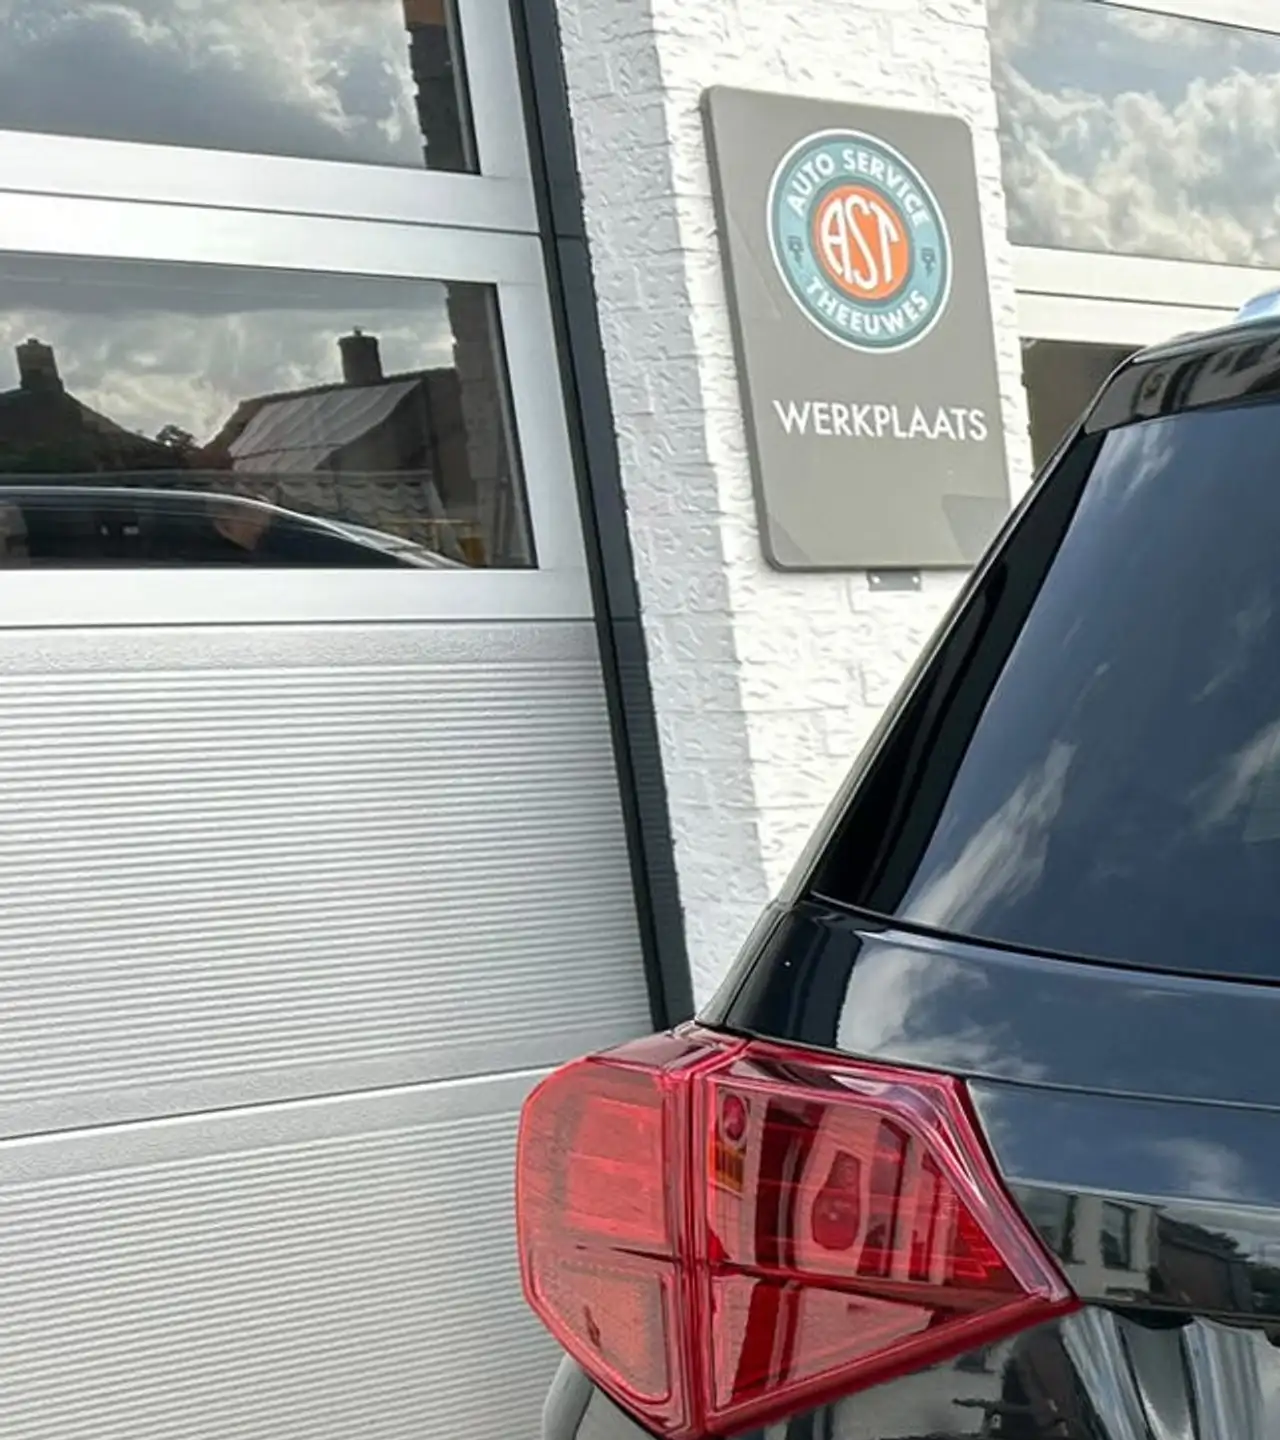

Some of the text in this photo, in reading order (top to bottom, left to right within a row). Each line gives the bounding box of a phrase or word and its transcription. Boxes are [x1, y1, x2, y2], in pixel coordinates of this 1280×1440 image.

[786, 147, 929, 228] AUTO SERVICE
[820, 194, 900, 291] AST
[807, 275, 928, 336] THEEUWES
[772, 399, 988, 442] WERKPLAATS
